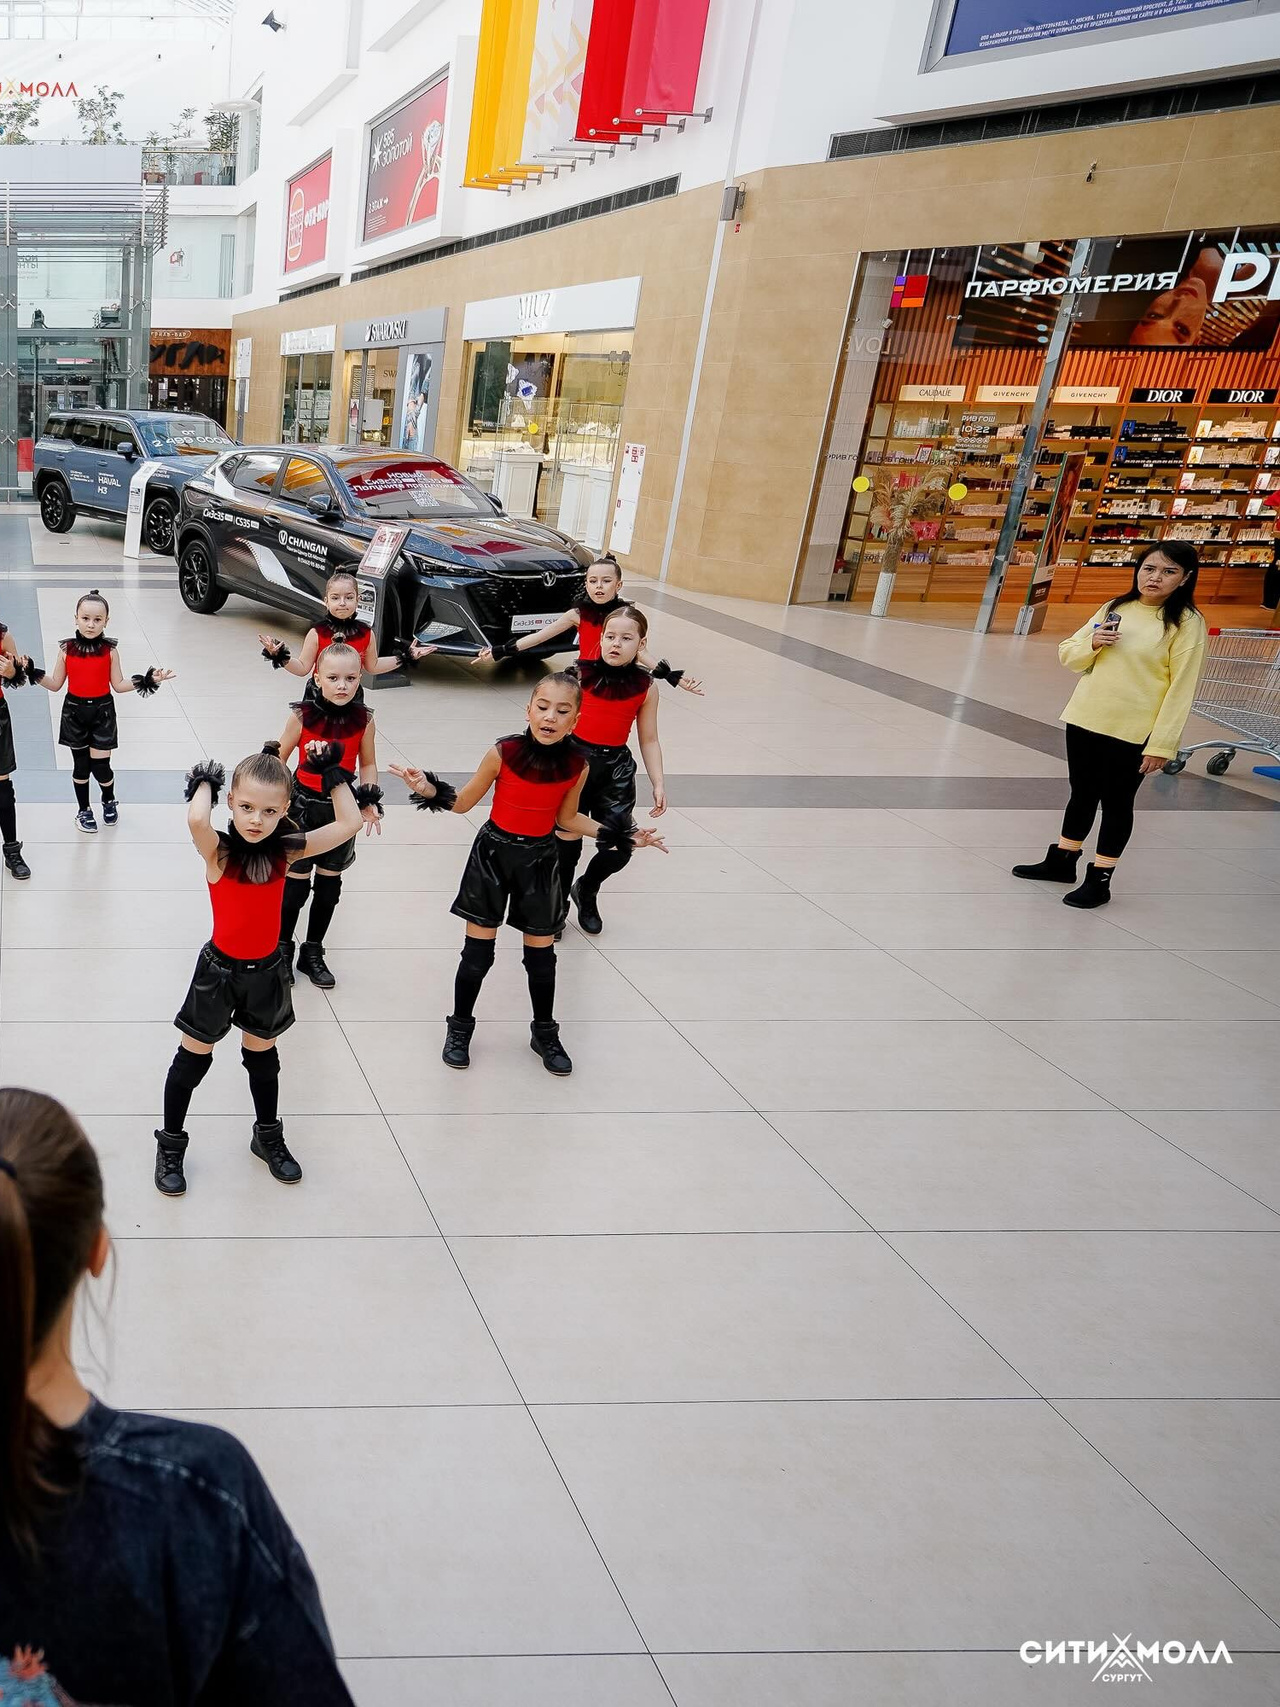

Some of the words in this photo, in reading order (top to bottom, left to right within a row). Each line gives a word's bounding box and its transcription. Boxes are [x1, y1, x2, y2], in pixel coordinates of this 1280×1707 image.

[20, 81, 78, 97] МОЛЛ
[382, 127, 395, 149] 585
[381, 131, 413, 167] ЗОЛОТОЙ
[304, 198, 330, 229] ФУД-КОР
[964, 271, 1179, 298] ПАРФЮМЕРИЯ
[370, 320, 408, 342] SWAROVSKI
[1146, 390, 1183, 403] DIOR
[1227, 390, 1265, 403] DIOR
[152, 440, 163, 448] 2
[98, 476, 121, 487] HAVAL
[97, 486, 108, 495] H3
[235, 517, 251, 529] CS35
[288, 535, 329, 557] CHANGAN
